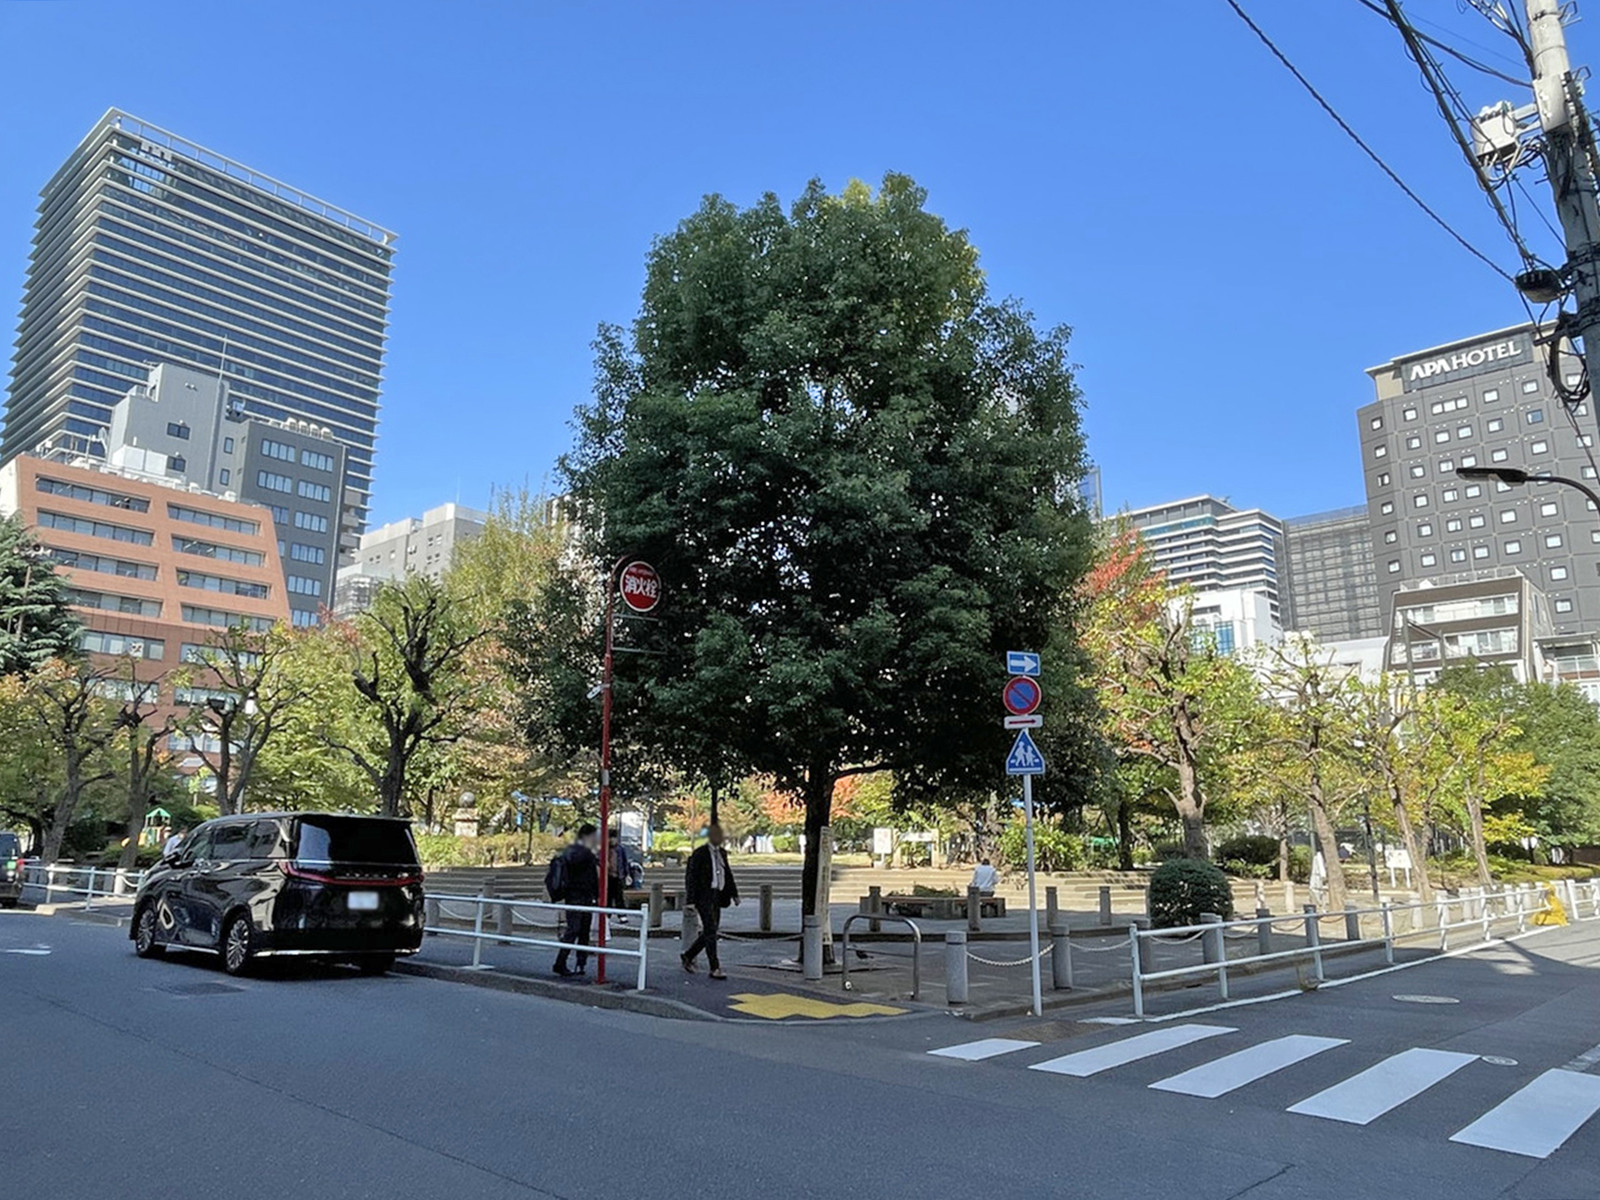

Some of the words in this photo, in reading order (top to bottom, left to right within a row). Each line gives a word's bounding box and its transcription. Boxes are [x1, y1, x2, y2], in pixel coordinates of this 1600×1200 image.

[1410, 359, 1451, 380] APA
[1451, 341, 1522, 371] HOTEL
[625, 574, 657, 598] 消火栓
